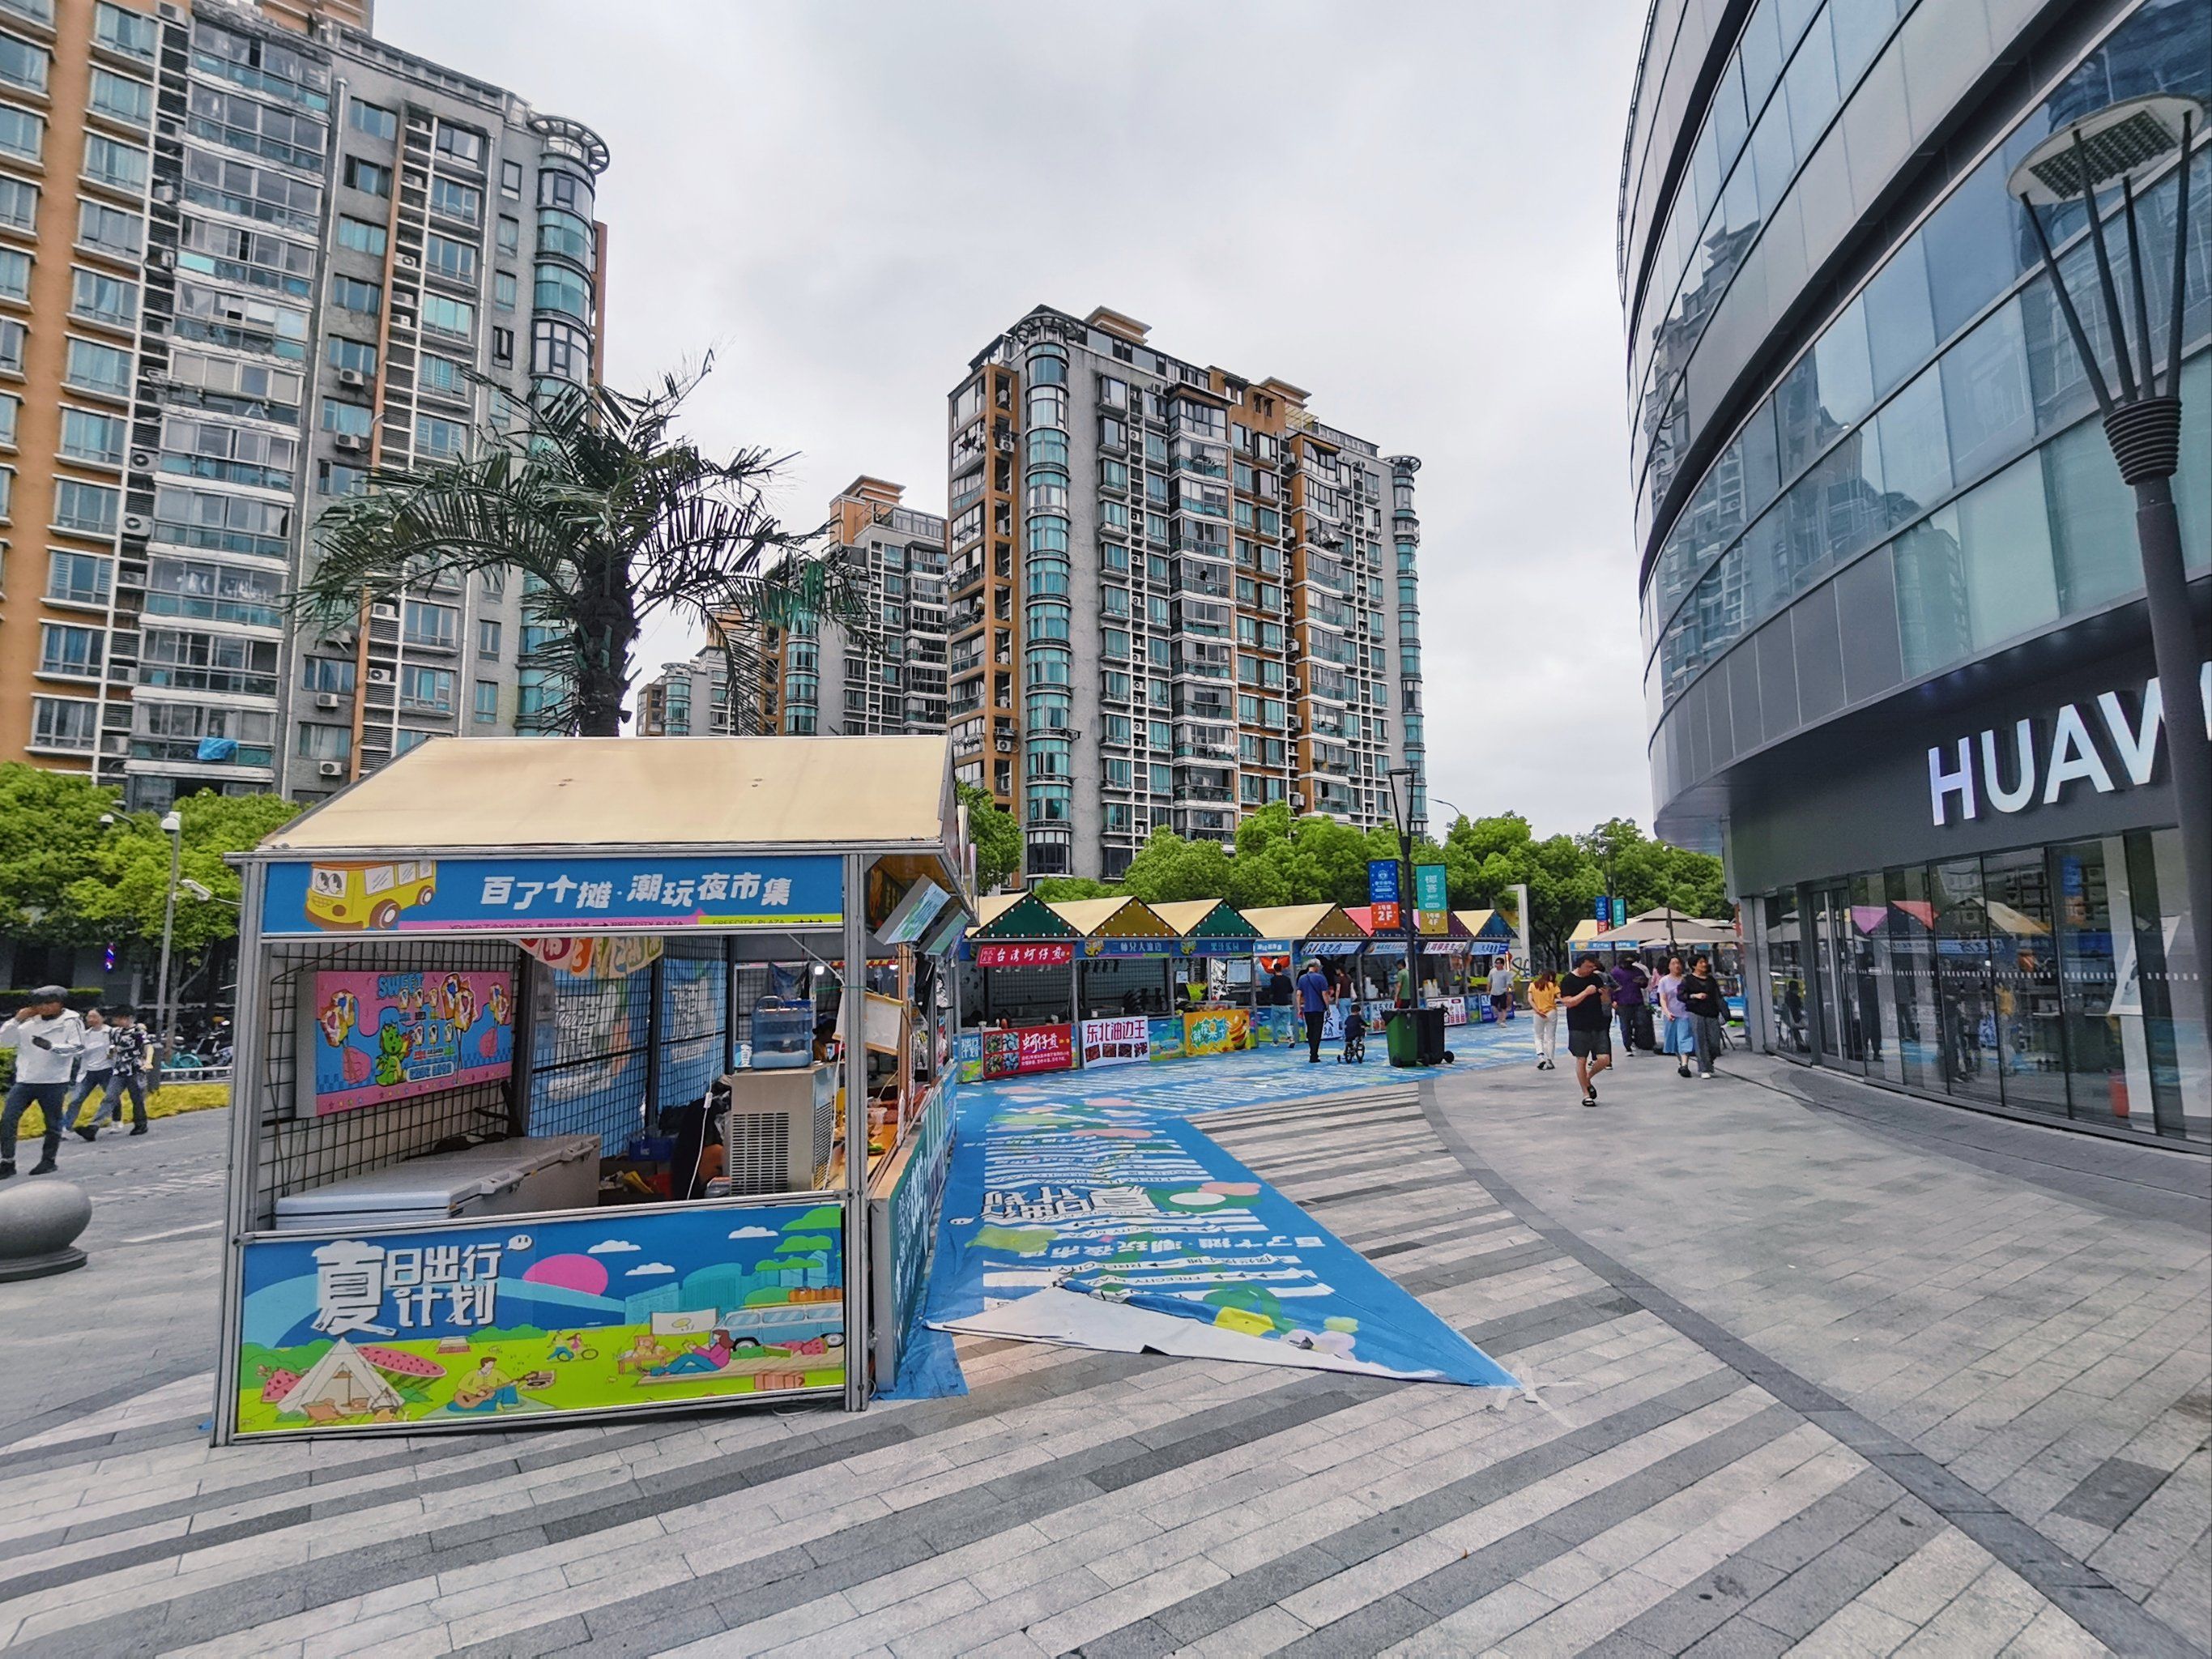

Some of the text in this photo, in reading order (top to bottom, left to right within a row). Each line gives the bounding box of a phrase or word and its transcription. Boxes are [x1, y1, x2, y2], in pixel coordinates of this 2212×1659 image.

[1929, 661, 2212, 825] HUAW
[1378, 911, 1392, 921] 2F
[1086, 1019, 1145, 1043] 东北油边王
